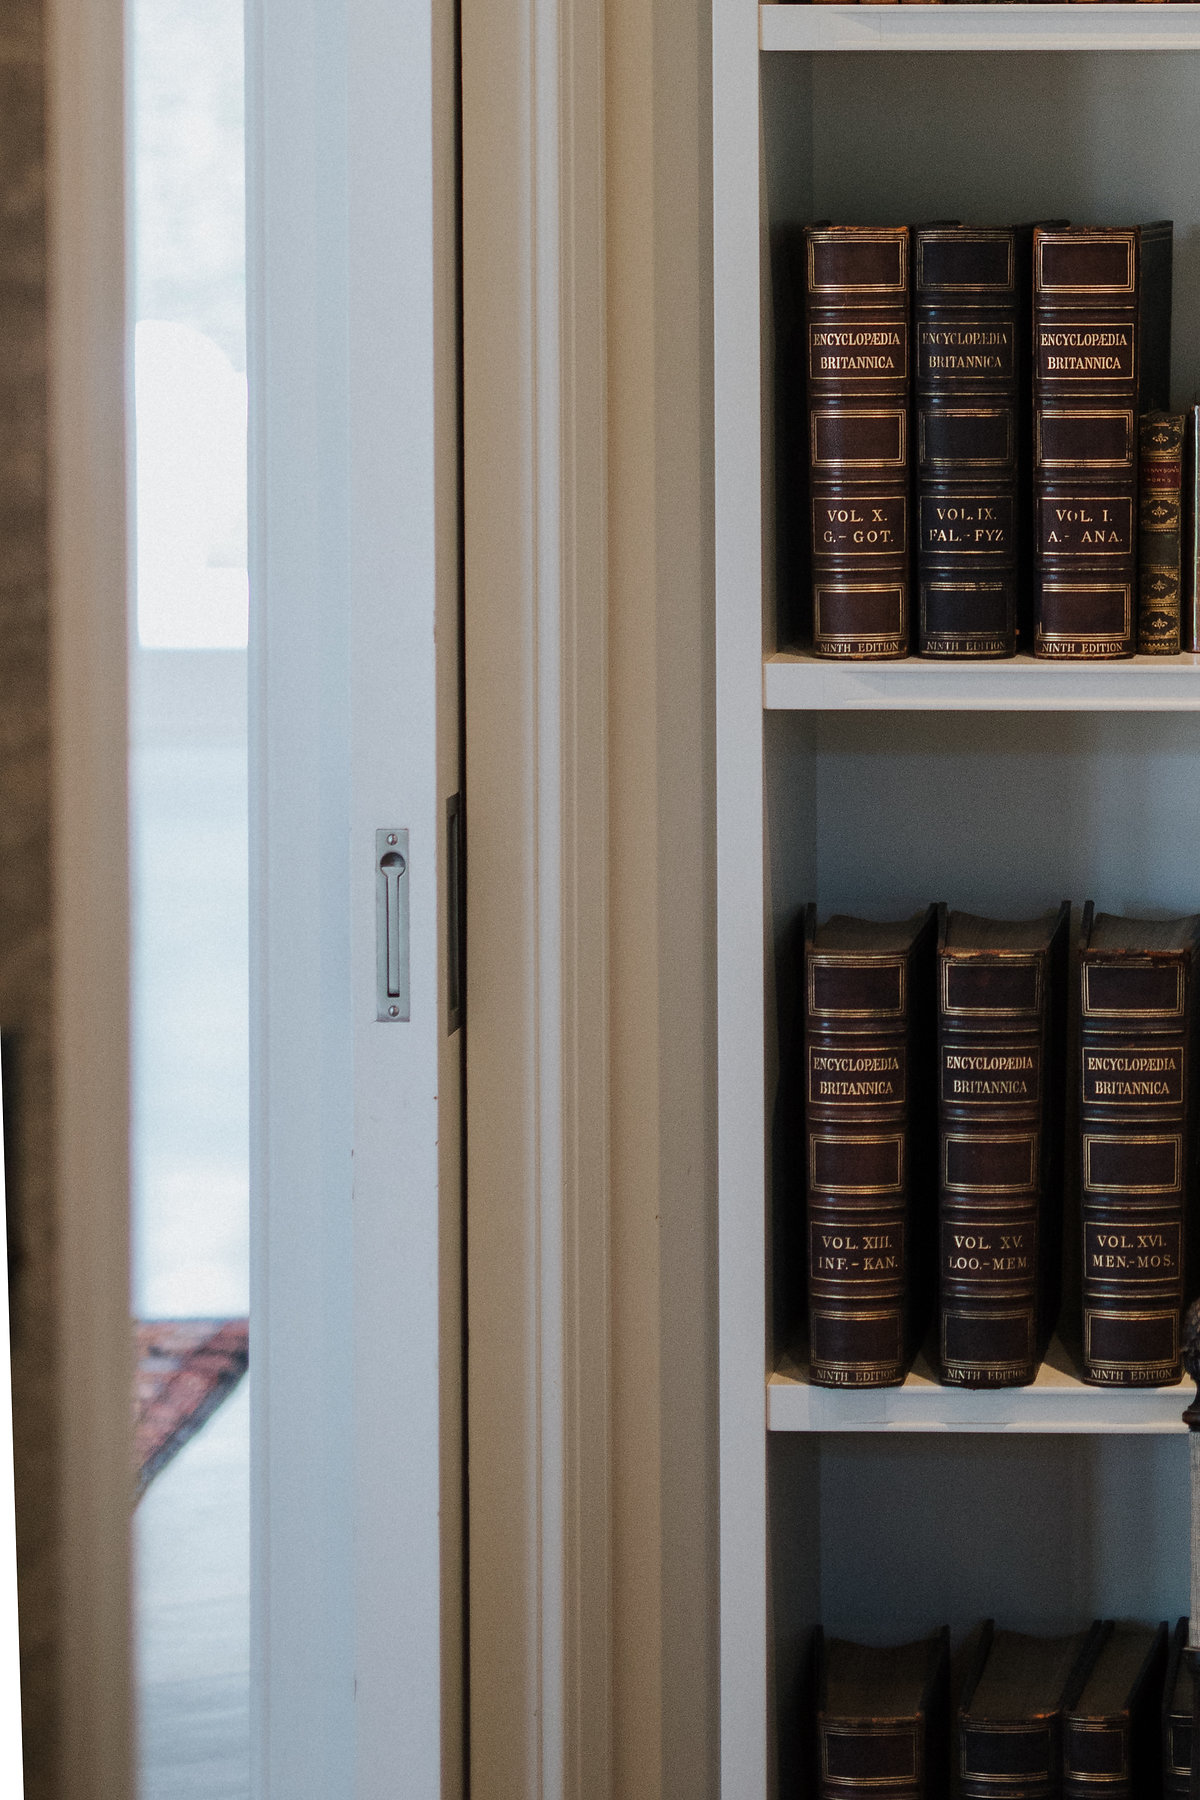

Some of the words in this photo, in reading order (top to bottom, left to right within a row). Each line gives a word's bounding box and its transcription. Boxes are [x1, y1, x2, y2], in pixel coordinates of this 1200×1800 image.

[813, 333, 900, 346] ENCYCLOPÆDIA
[922, 333, 1008, 345] ENCYCLOPÆDIA
[1040, 333, 1128, 346] ENCYCLOPÆDIA
[820, 356, 895, 369] BRITANNICA
[928, 355, 1003, 369] BRITANNICA
[1047, 356, 1122, 370] BRITANNICA
[827, 509, 864, 523] VOL.
[872, 509, 888, 522] X.
[936, 508, 974, 521] VOL.
[1056, 509, 1094, 522] VOL.
[1102, 509, 1113, 522] I.
[820, 642, 851, 652] NINTH
[858, 641, 899, 652] EDITION
[926, 640, 959, 651] NINTH
[966, 640, 1006, 651] EDITION
[1042, 642, 1076, 652] NINTH
[1082, 642, 1123, 653] EDITION
[813, 1056, 899, 1071] ENCYCLOPÆDIA
[946, 1056, 1034, 1071] ENCYCLOPÆDIA
[1088, 1057, 1177, 1071] ENCYCLOPÆDIA
[820, 1081, 893, 1095] BRITANNICA
[953, 1080, 1027, 1095] BRITANNICA
[1095, 1081, 1170, 1096] BRITANNICA
[822, 1235, 859, 1250] VOL.
[862, 1236, 892, 1250] XIII.
[954, 1235, 992, 1250] VOL.
[1000, 1235, 1023, 1249] XV.
[1097, 1235, 1133, 1249] VOL.
[1136, 1235, 1167, 1249] XVI.
[816, 1369, 849, 1381] NINTH
[855, 1369, 897, 1381] EDITION
[947, 1368, 981, 1381] NINTH
[987, 1368, 1027, 1380] EDITION
[1091, 1369, 1124, 1380] NINTH
[1130, 1369, 1173, 1380] EDITION
